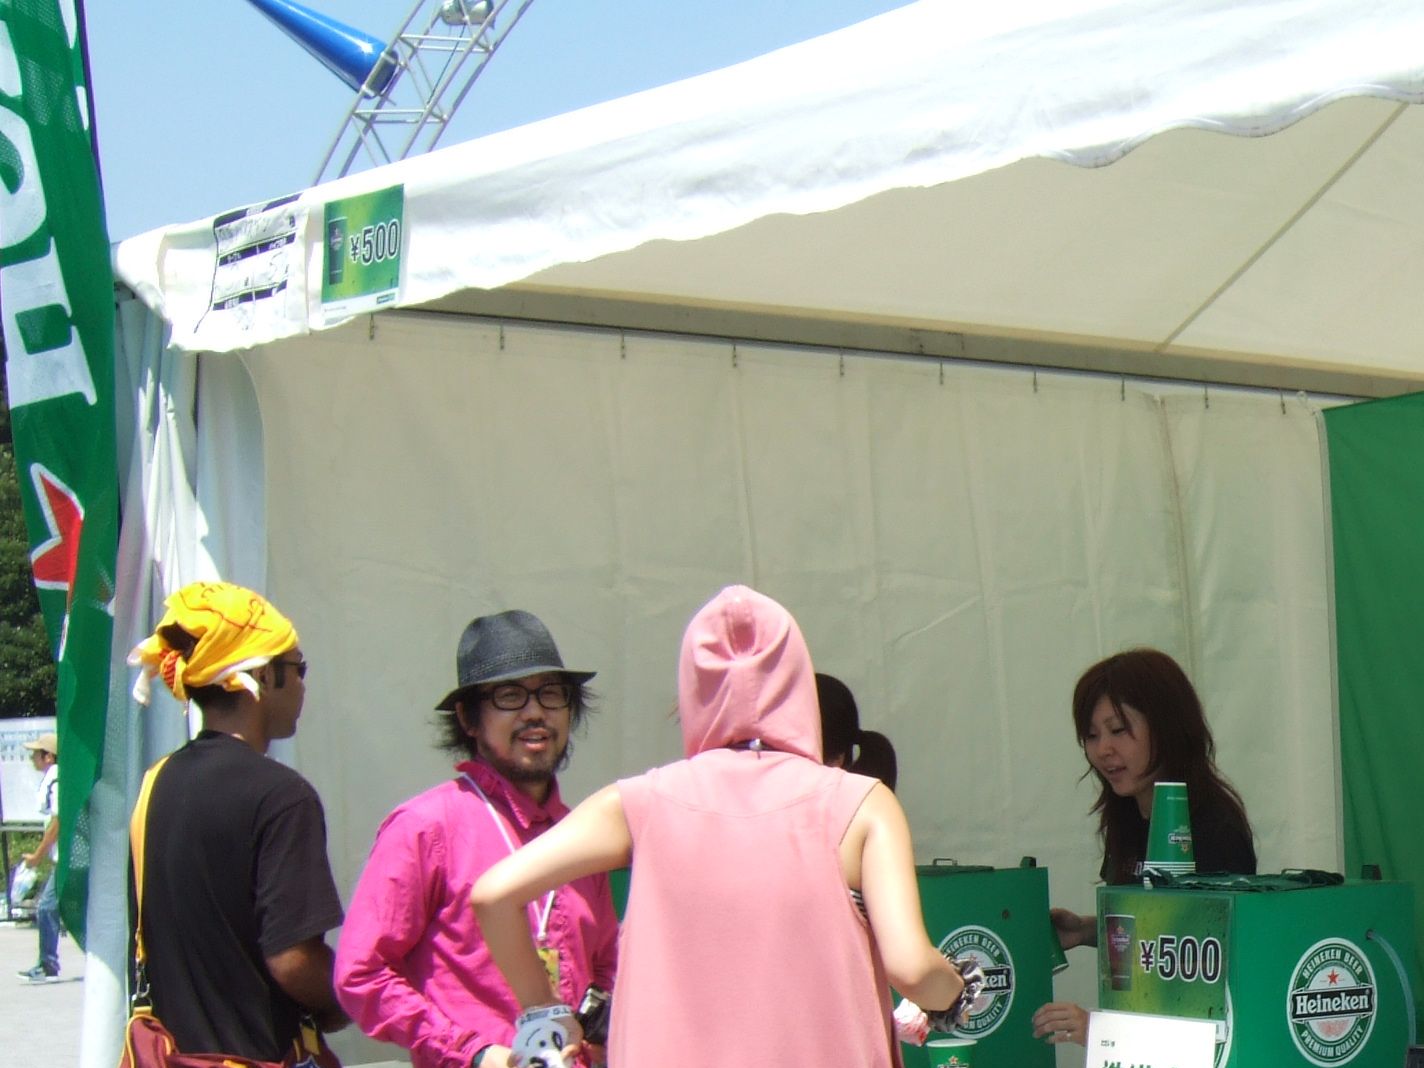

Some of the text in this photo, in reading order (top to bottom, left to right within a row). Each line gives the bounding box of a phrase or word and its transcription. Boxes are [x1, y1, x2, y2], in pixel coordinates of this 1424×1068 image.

[350, 218, 399, 266] ¥500
[1139, 934, 1222, 984] ¥500
[1302, 948, 1363, 979] HEINEKEN BEER
[1295, 991, 1369, 1016] Heineken
[1301, 1026, 1364, 1057] PREMIUM QUALITY
